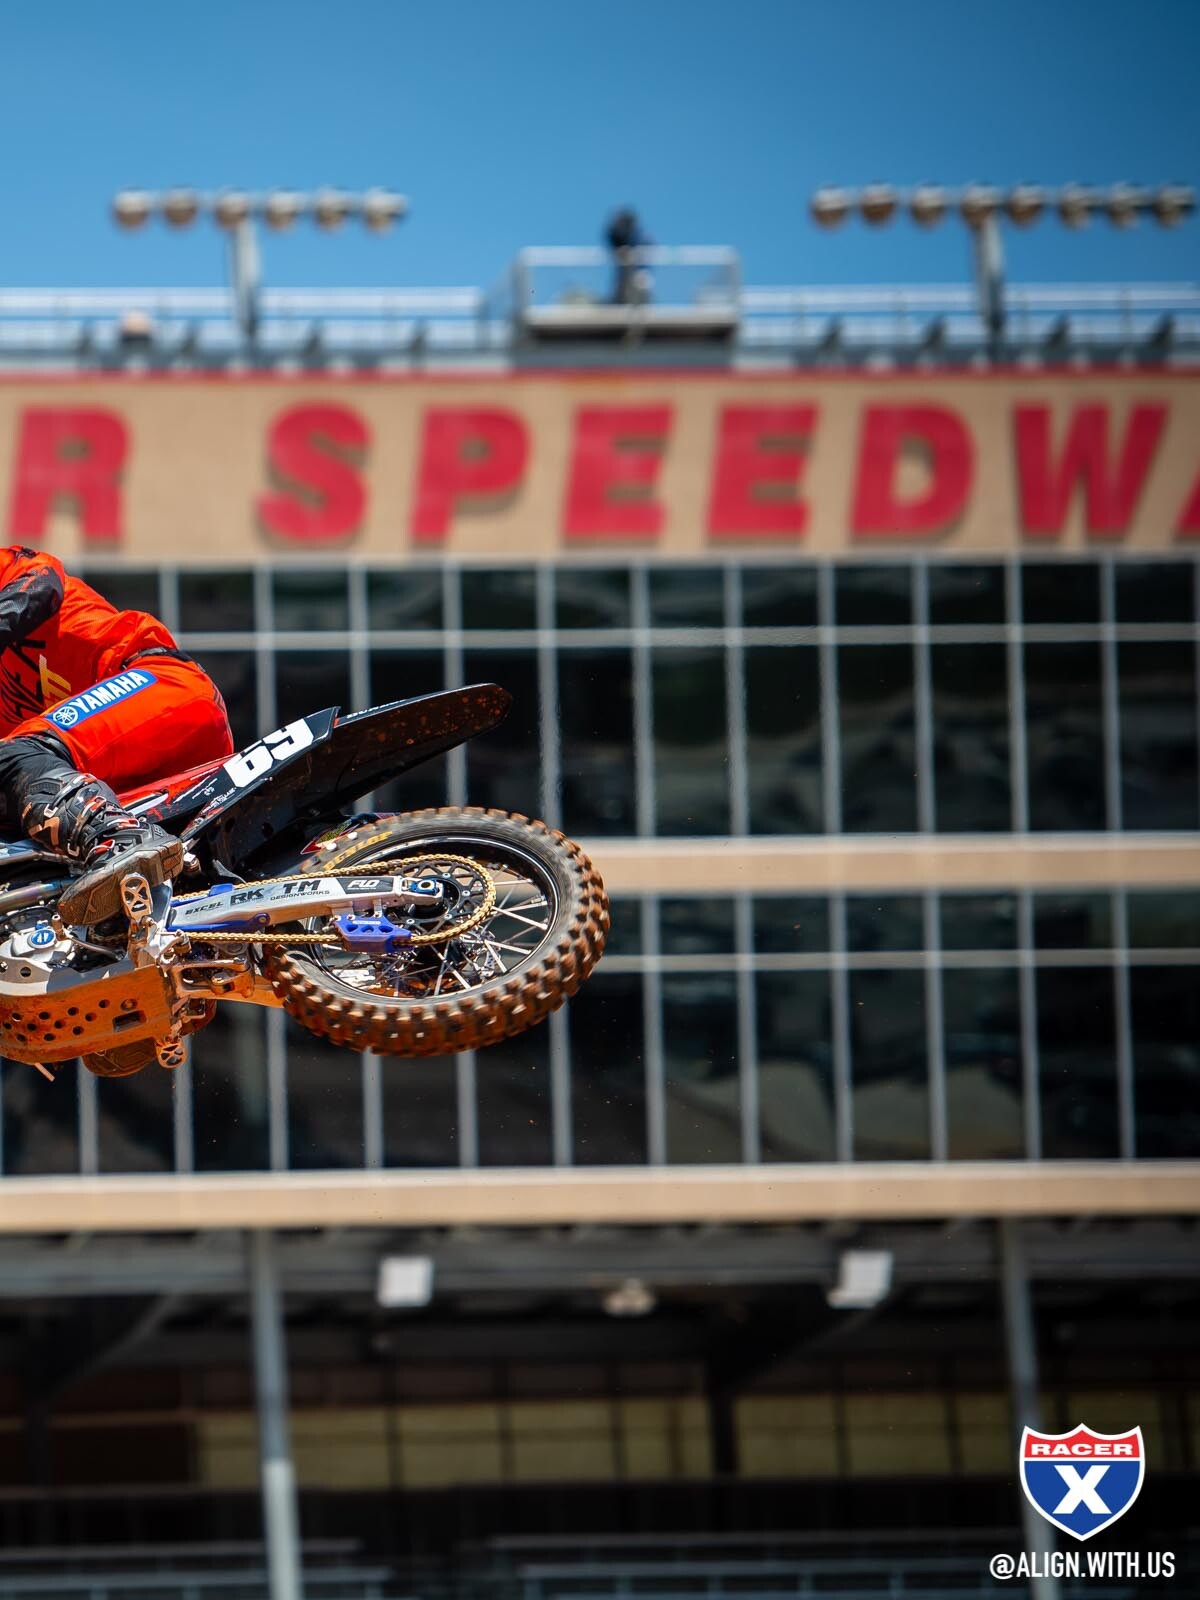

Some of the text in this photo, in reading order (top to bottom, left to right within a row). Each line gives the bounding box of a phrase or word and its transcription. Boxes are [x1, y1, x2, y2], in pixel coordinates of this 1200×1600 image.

[257, 399, 1200, 543] SPEEDW
[68, 671, 149, 713] YAMAHA
[222, 717, 314, 787] 69
[230, 887, 265, 906] RK
[282, 879, 322, 894] TM
